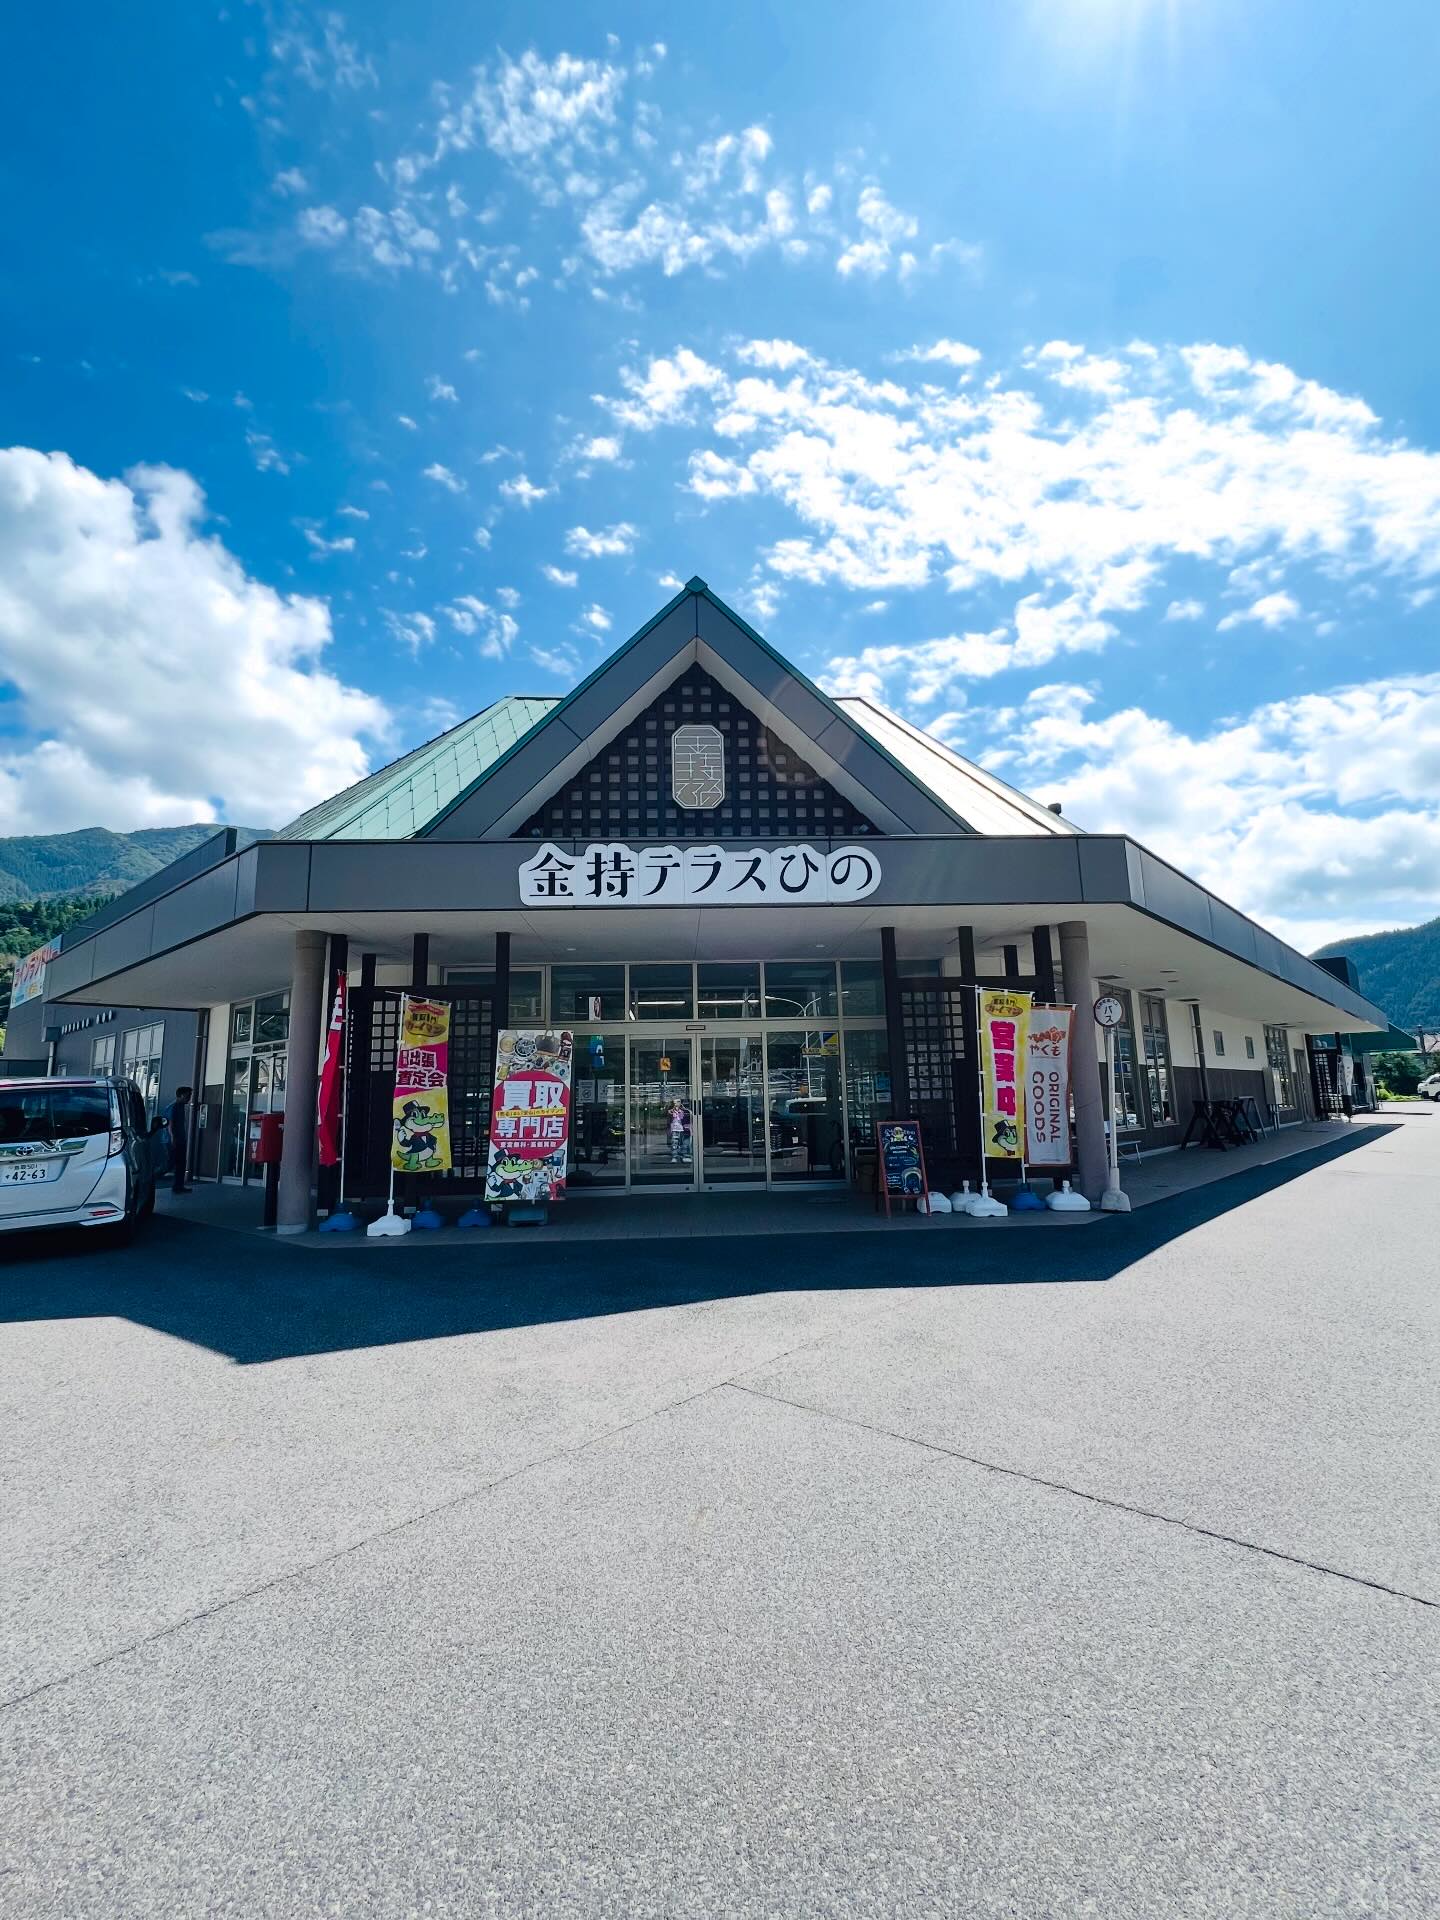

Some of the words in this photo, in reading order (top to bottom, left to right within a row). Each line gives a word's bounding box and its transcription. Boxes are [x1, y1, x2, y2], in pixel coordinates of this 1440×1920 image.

[527, 851, 873, 898] 金持テラスひの
[1104, 1005, 1113, 1023] バス
[1029, 1044, 1062, 1056] やくも
[396, 1071, 446, 1088] 査定会
[501, 1081, 564, 1111] 買取
[1048, 1071, 1062, 1143] ORIGINAL
[495, 1116, 565, 1138] 専門店
[12, 1168, 46, 1181] 42-63
